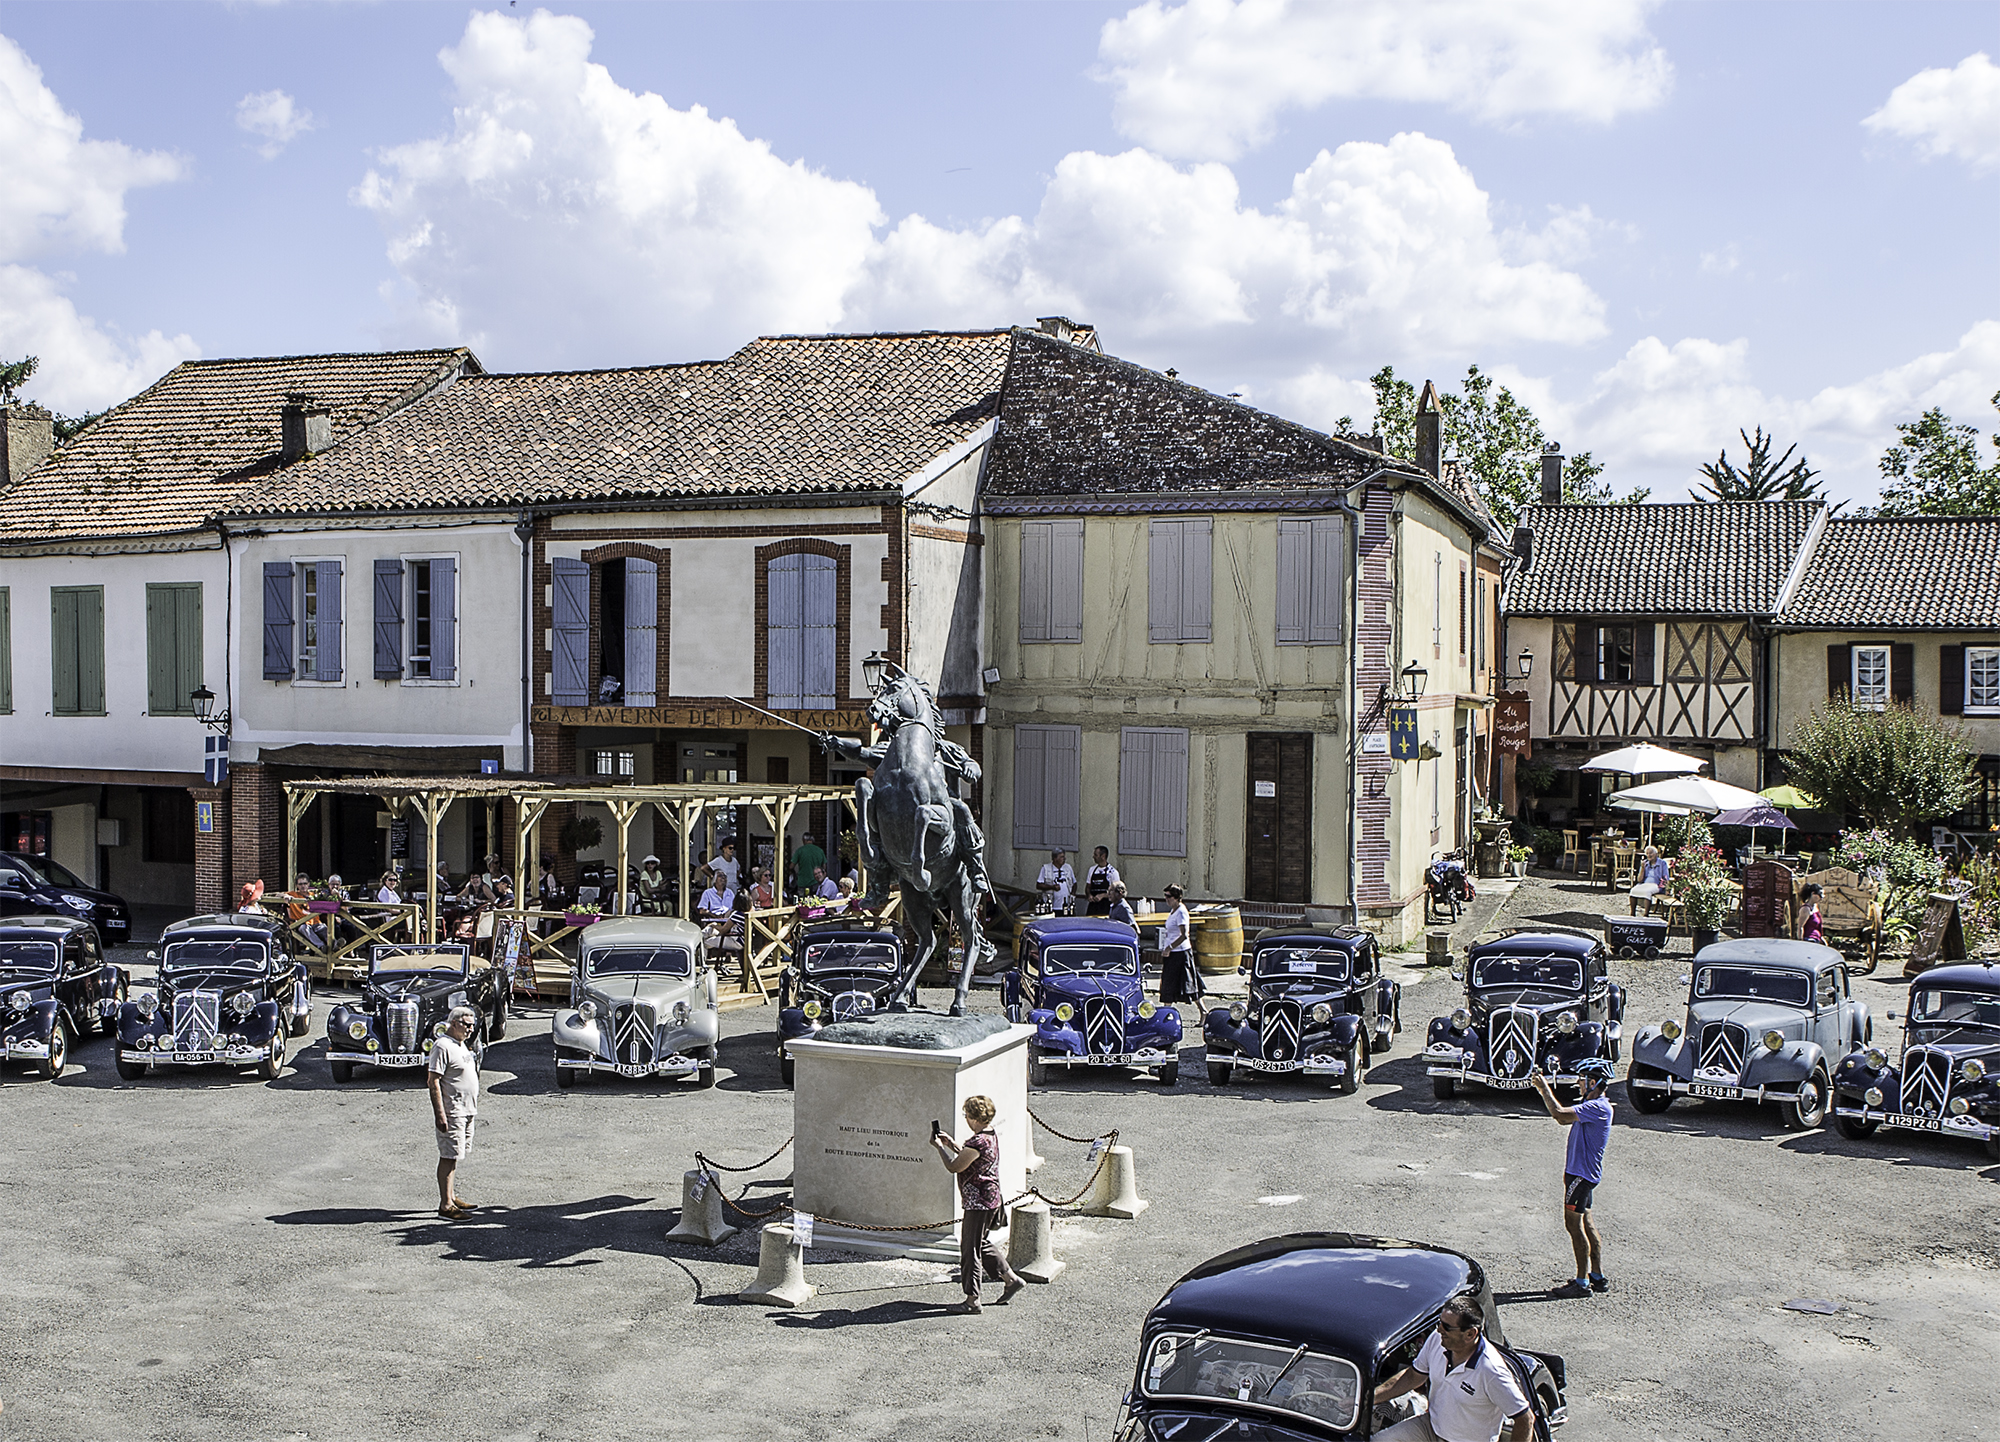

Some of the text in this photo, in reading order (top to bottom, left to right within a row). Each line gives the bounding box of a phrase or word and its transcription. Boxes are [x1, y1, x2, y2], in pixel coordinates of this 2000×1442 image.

[547, 707, 869, 728] LA TAVERNE DE D'ARTAGNA
[1498, 735, 1526, 751] Rouge
[1626, 936, 1654, 944] GLACES
[175, 1052, 212, 1061] BA-056-TL
[1090, 1055, 1099, 1064] 20
[1888, 1115, 1912, 1127] 4129
[1912, 1118, 1926, 1129] PZ
[1926, 1120, 1939, 1130] 40
[872, 1129, 909, 1138] HISTORIQUE
[825, 1148, 923, 1163] ROUTE EUROPÉENNE D'ARTAGNAN
